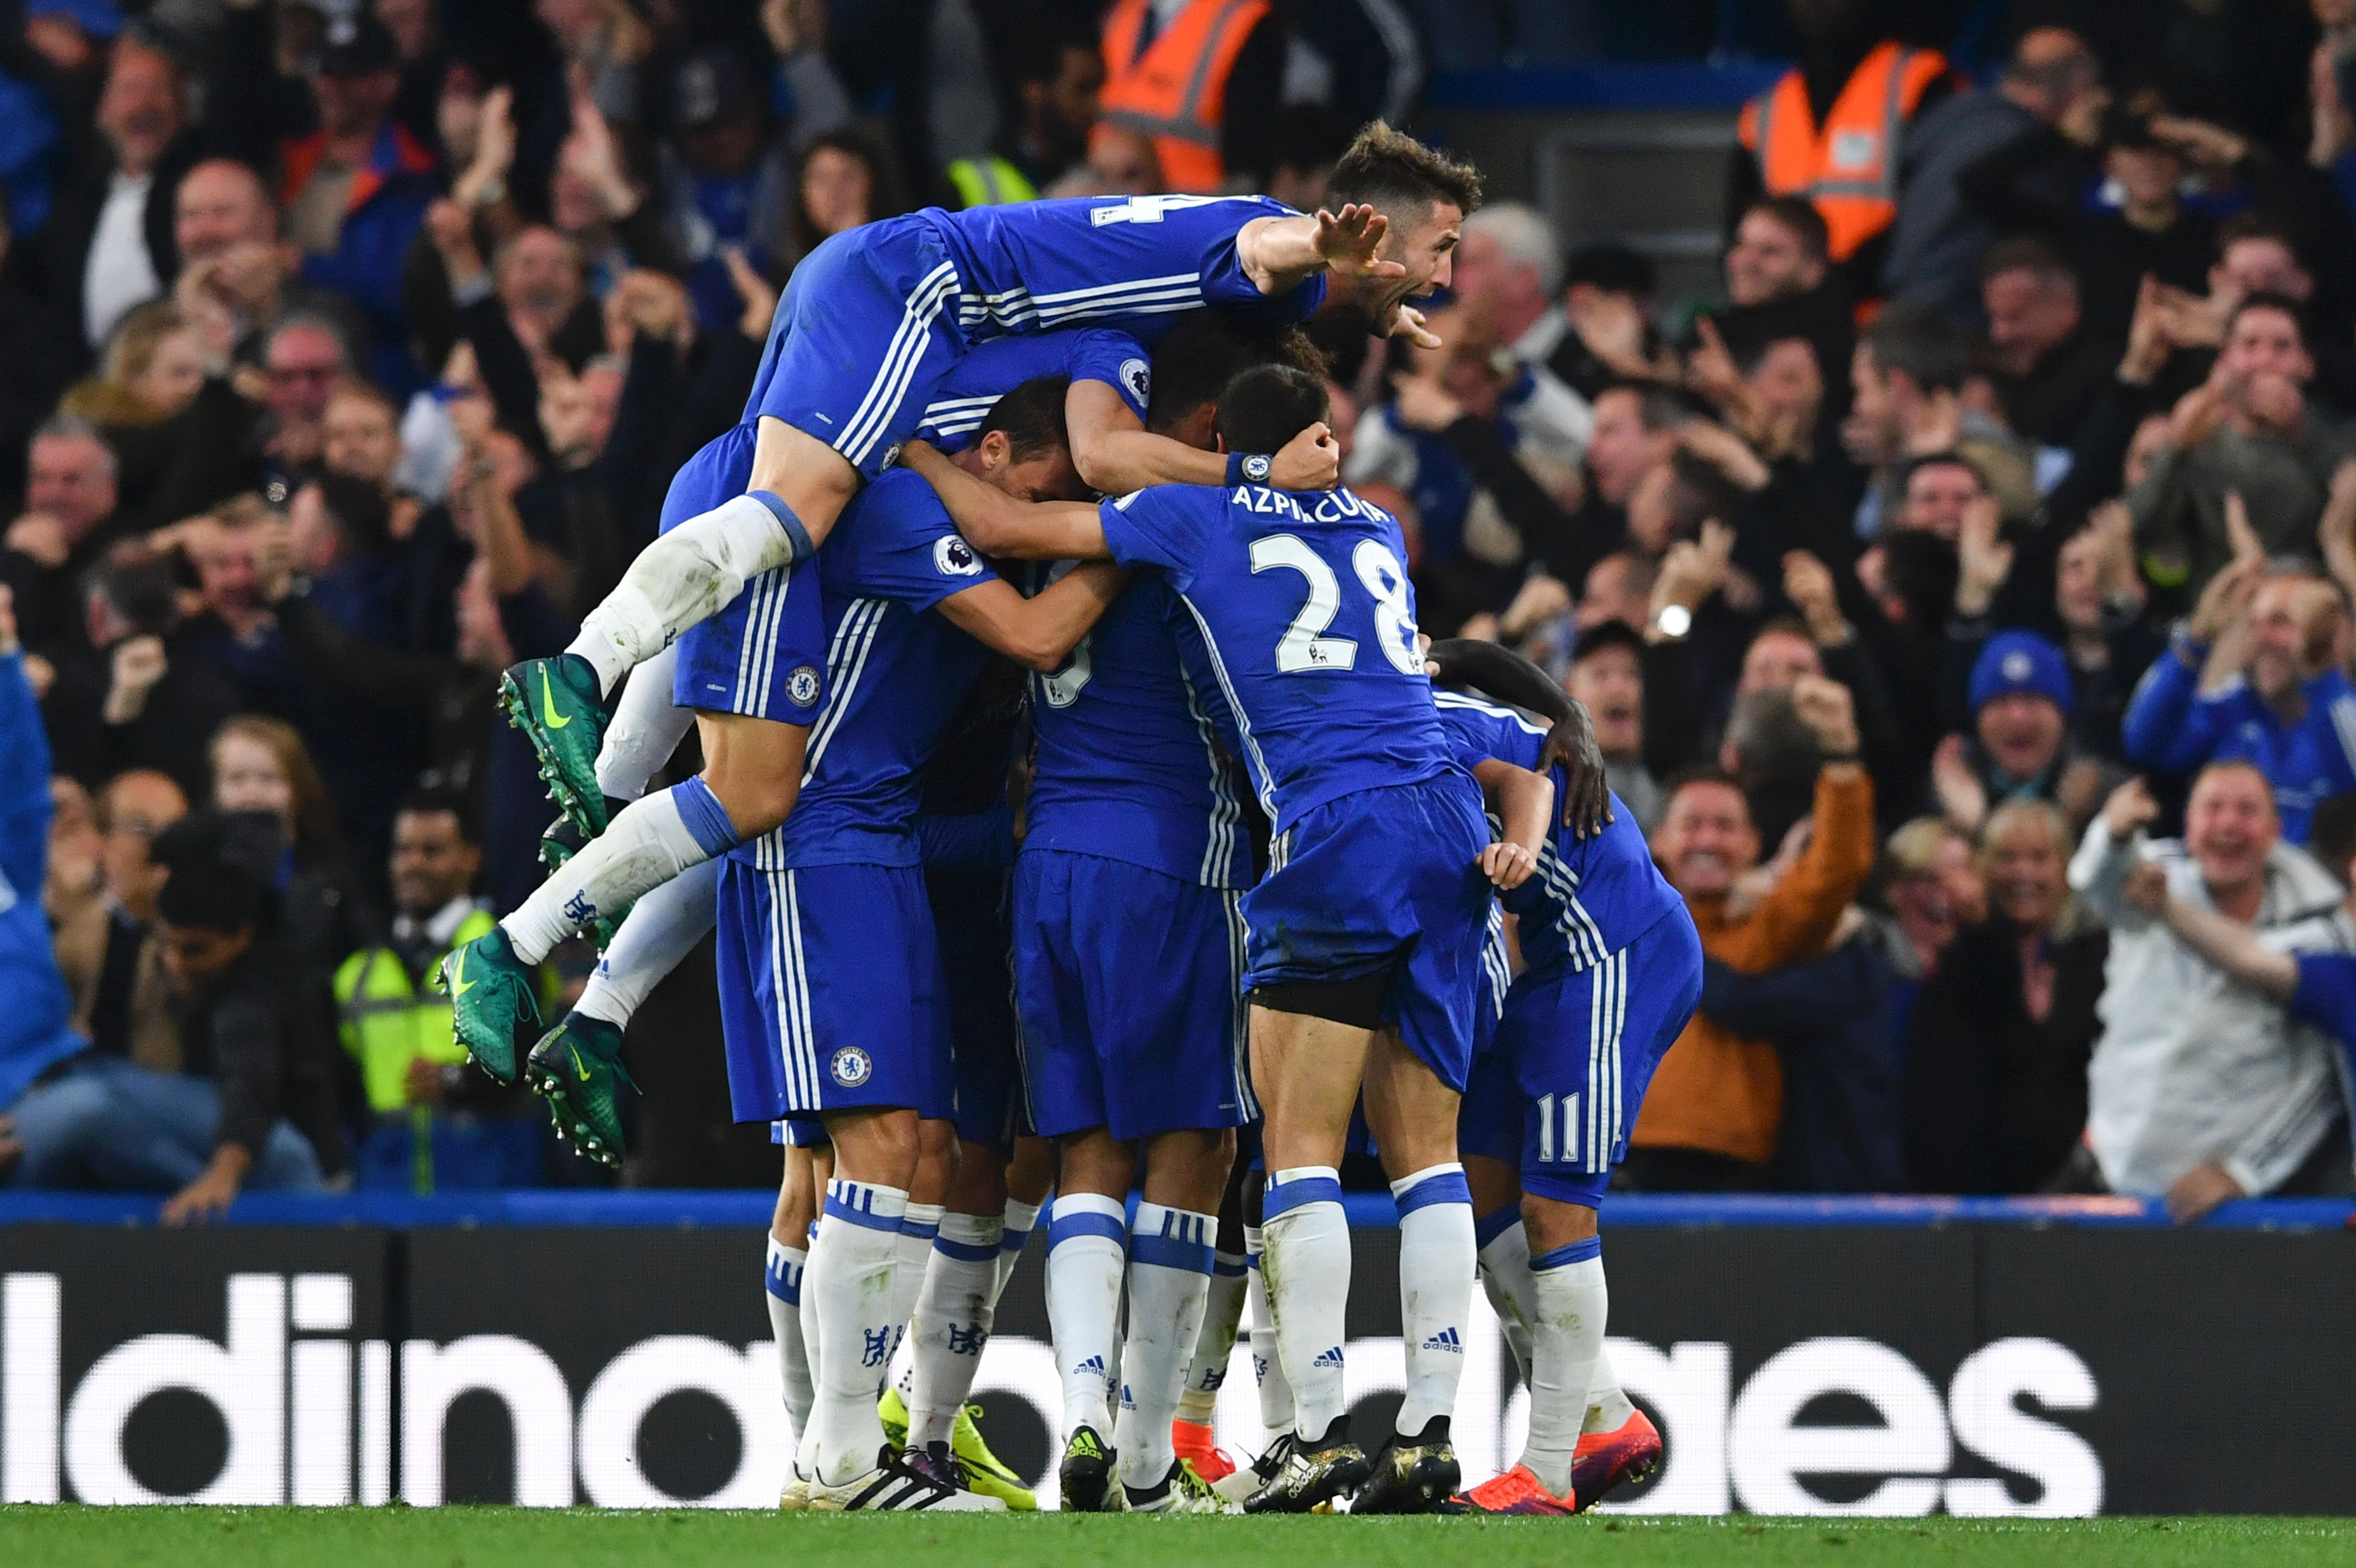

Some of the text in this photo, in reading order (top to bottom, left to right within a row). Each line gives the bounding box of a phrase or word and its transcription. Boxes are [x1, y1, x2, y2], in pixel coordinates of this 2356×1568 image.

[1248, 533, 1425, 675] 28
[1537, 1092, 1580, 1162] 11
[1313, 1359, 1344, 1368] adida
[1423, 1341, 1463, 1354] adidas
[1288, 1463, 1320, 1499] adidas
